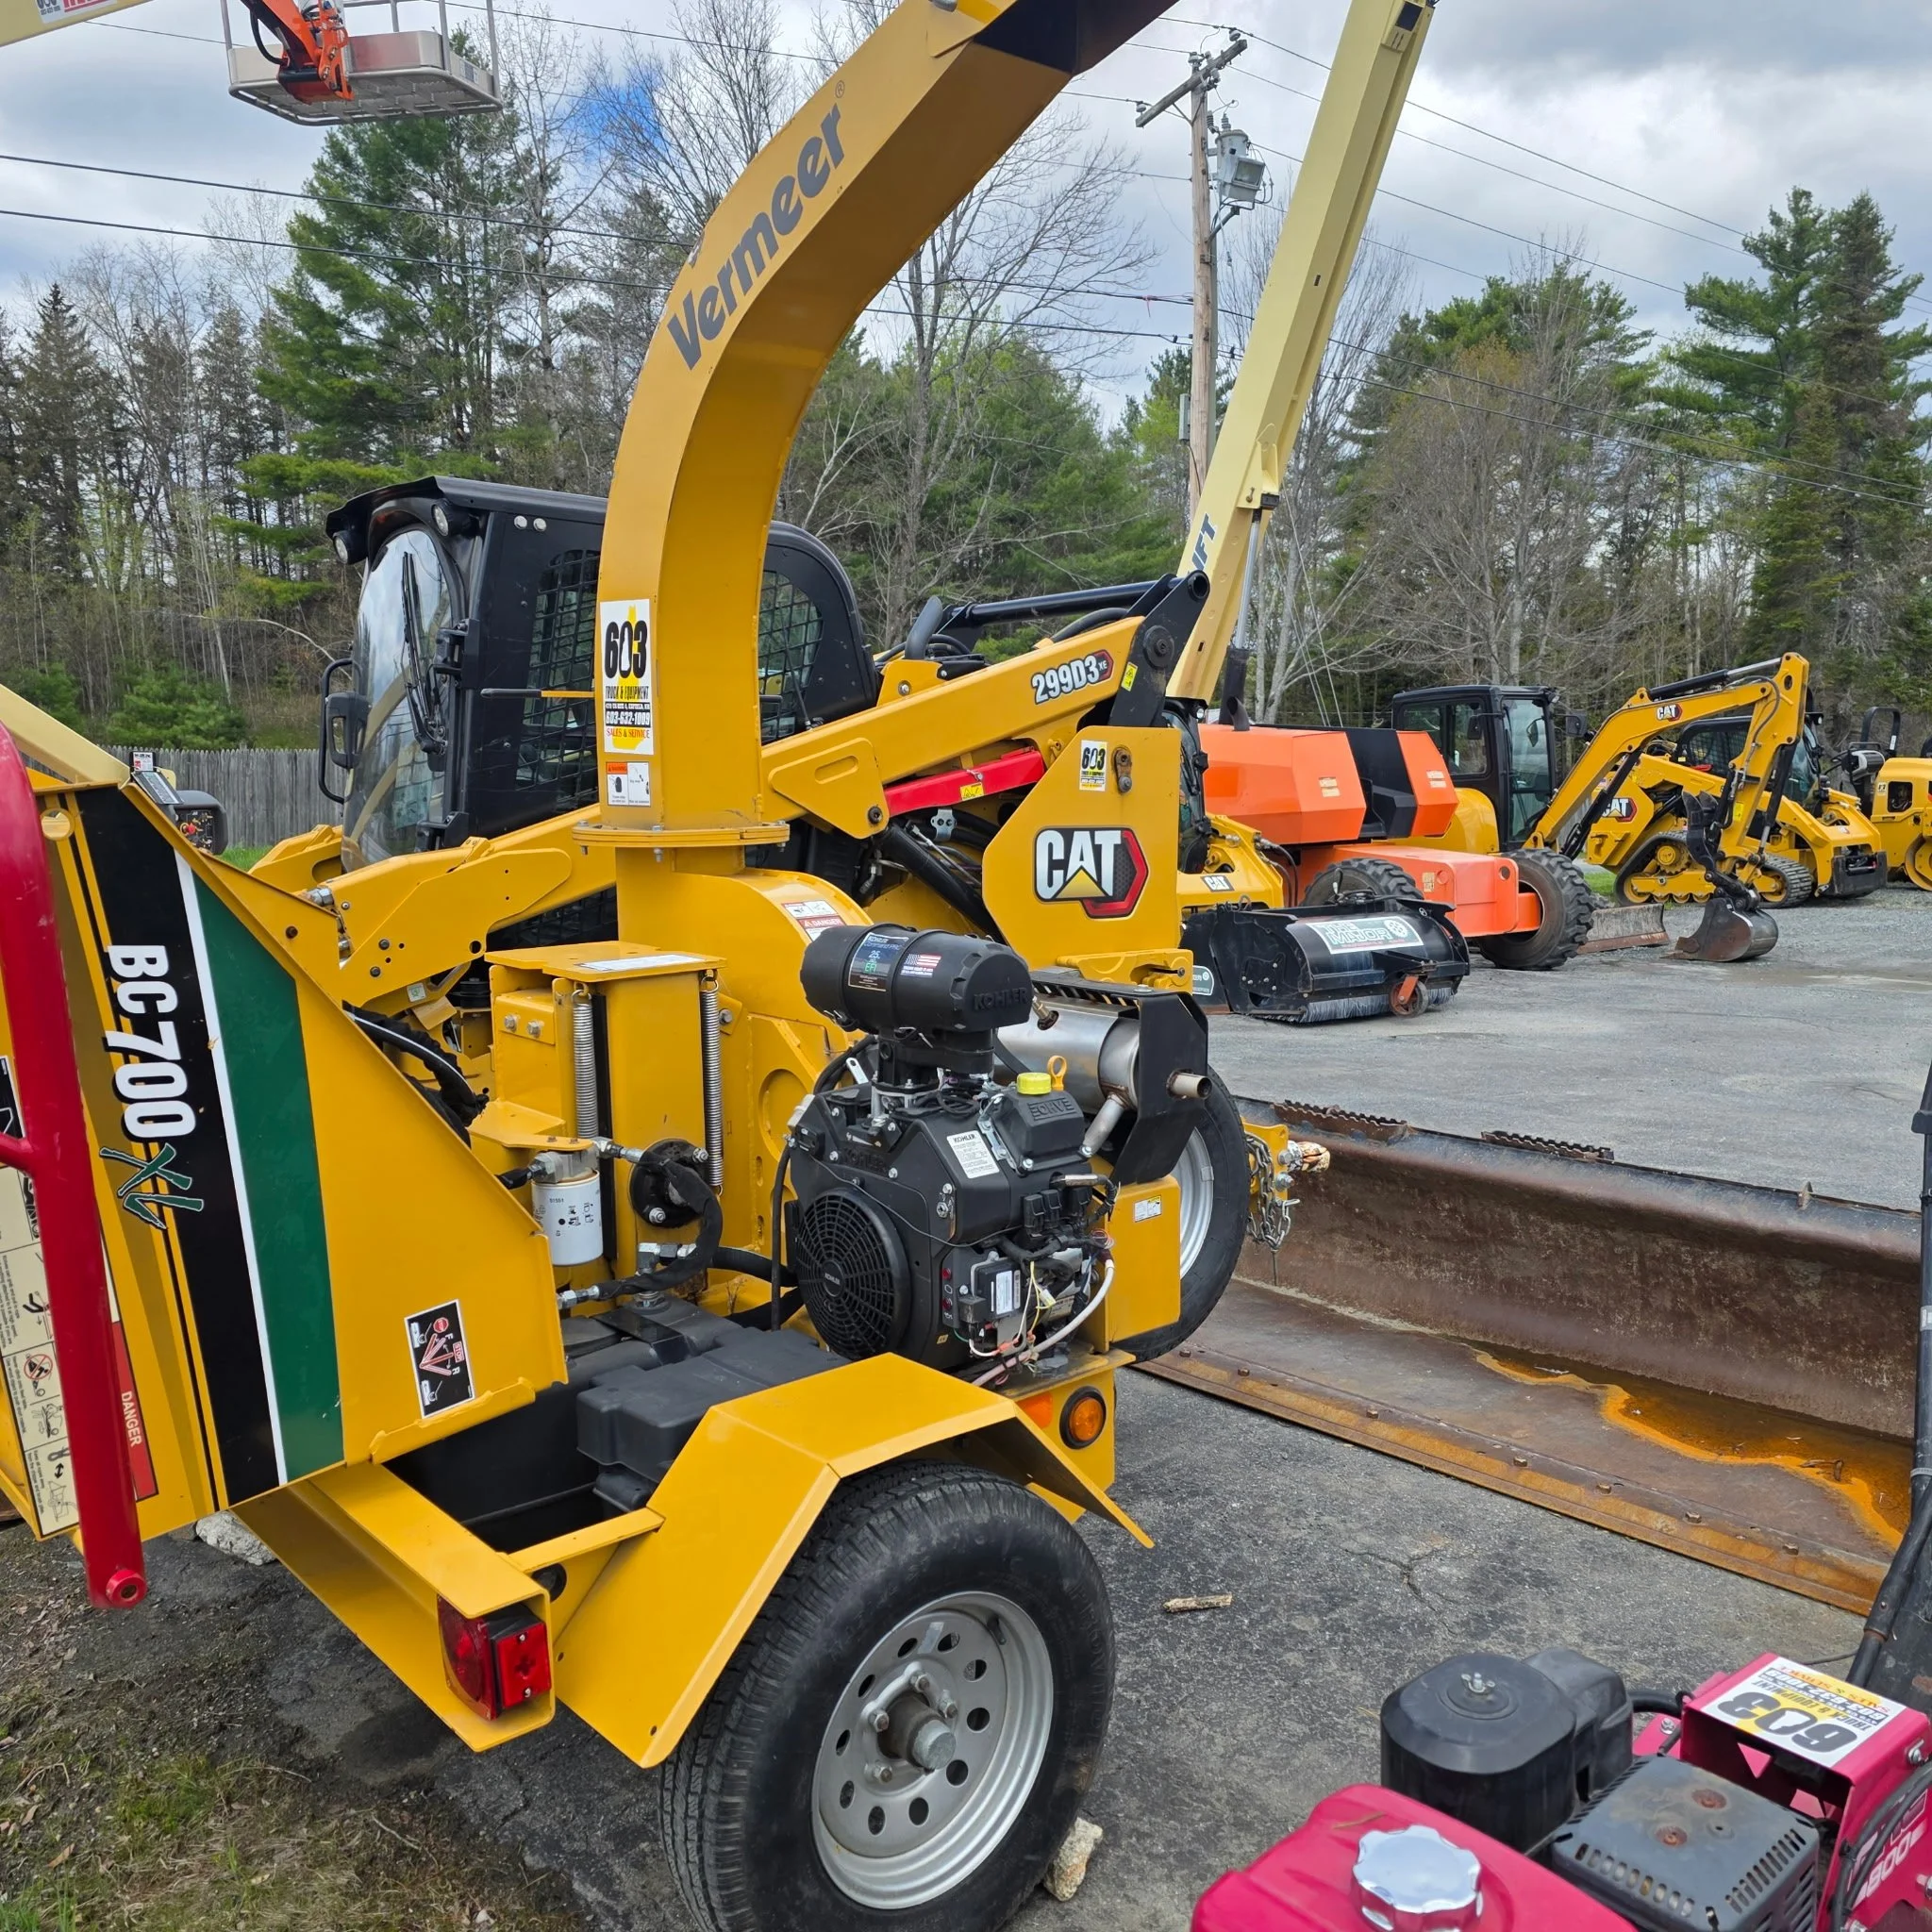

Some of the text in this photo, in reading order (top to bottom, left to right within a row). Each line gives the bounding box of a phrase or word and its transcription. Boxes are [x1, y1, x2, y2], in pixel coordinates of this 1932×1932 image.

[667, 103, 844, 371] Vermeer
[605, 620, 647, 678] 603
[1031, 654, 1108, 704] 299D3 XE
[606, 686, 649, 700] TRUCK & EQUIPMENT
[606, 711, 650, 725] 603-632-1009
[1657, 705, 1677, 720] CAT
[607, 728, 650, 739] SALES & SERVICE
[1082, 747, 1106, 770] 603
[1037, 830, 1121, 899] CAT
[1204, 875, 1230, 891] CAT
[1321, 922, 1358, 933] THE
[1327, 928, 1393, 944] MAJOR
[974, 988, 1028, 1011] KOHLER
[105, 945, 195, 1138] BC700
[954, 1134, 975, 1142] KOHLER
[122, 1391, 142, 1447] DANGER
[1780, 1667, 1830, 1689] SERVICE
[1751, 1680, 1819, 1708] EQUIPMENT
[1765, 1669, 1886, 1720] 603-632-1009
[1849, 1694, 1889, 1712] SALES
[1717, 1691, 1857, 1753] 603
[1829, 1712, 1871, 1731] TRUCK
